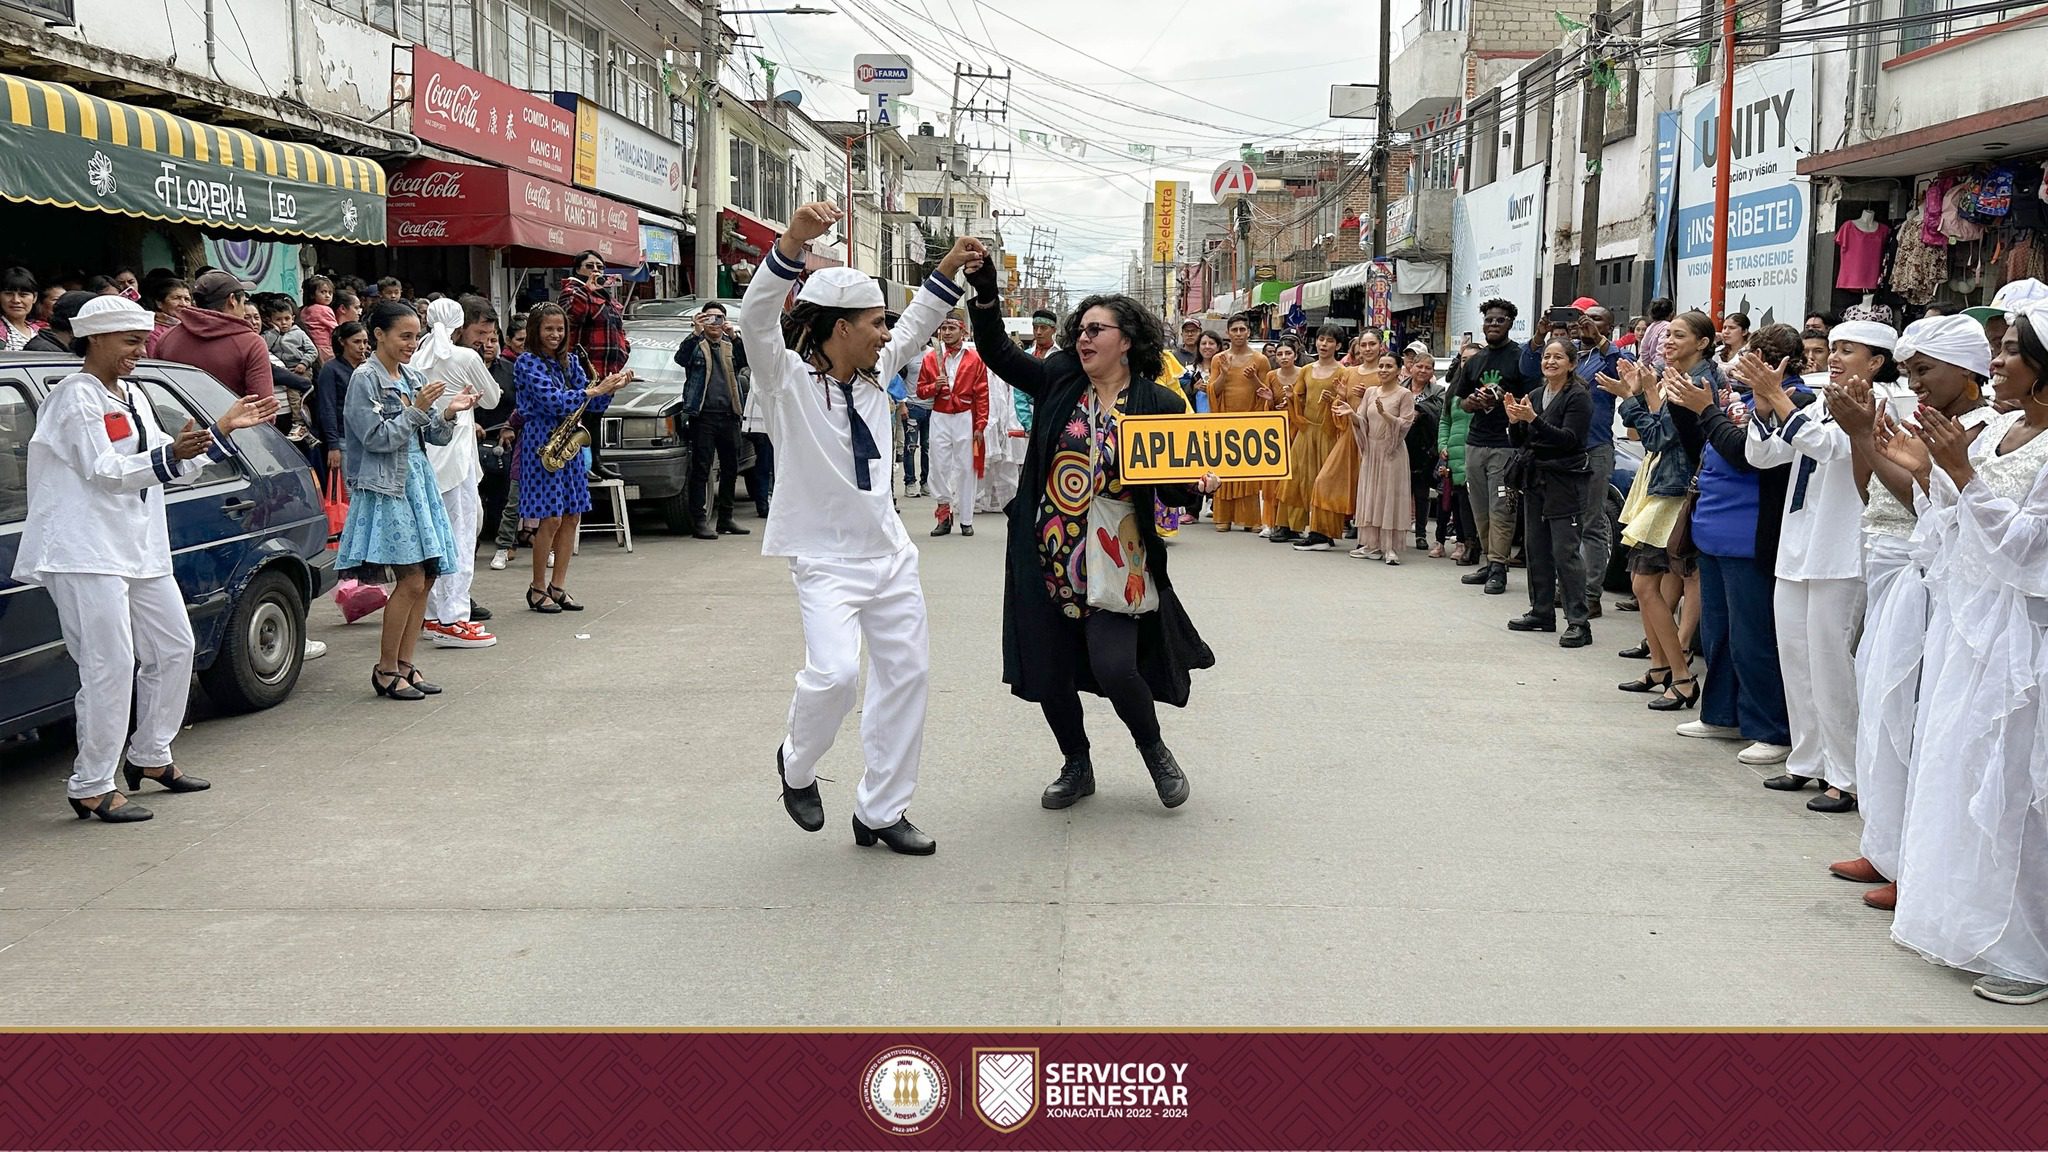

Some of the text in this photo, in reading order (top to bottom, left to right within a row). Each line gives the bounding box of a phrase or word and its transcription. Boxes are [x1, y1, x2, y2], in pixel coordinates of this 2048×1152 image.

[425, 73, 481, 129] Coca-Cola
[523, 107, 570, 138] COMIDA CHINA
[1702, 88, 1796, 169] UNITY
[530, 138, 550, 157] KANG
[551, 147, 562, 162] TAI
[387, 171, 465, 198] Coca-Cola
[1712, 161, 1777, 187] Eación y visión
[525, 181, 552, 213] Coca-Cola
[564, 191, 583, 207] COMIDA
[1509, 193, 1535, 221] UNITY
[564, 204, 586, 226] KANG
[586, 210, 598, 229] TAI
[1158, 188, 1172, 238] elektra
[1687, 198, 1794, 253] ¡INSRÍBETE!
[398, 220, 449, 238] Coca-Cola
[1480, 264, 1513, 281] LICENCIATURAS
[1735, 250, 1794, 271] TRASCIENDE
[1757, 277, 1762, 287] Y
[1763, 268, 1798, 287] BECAS
[1129, 428, 1281, 469] APLAUSOS
